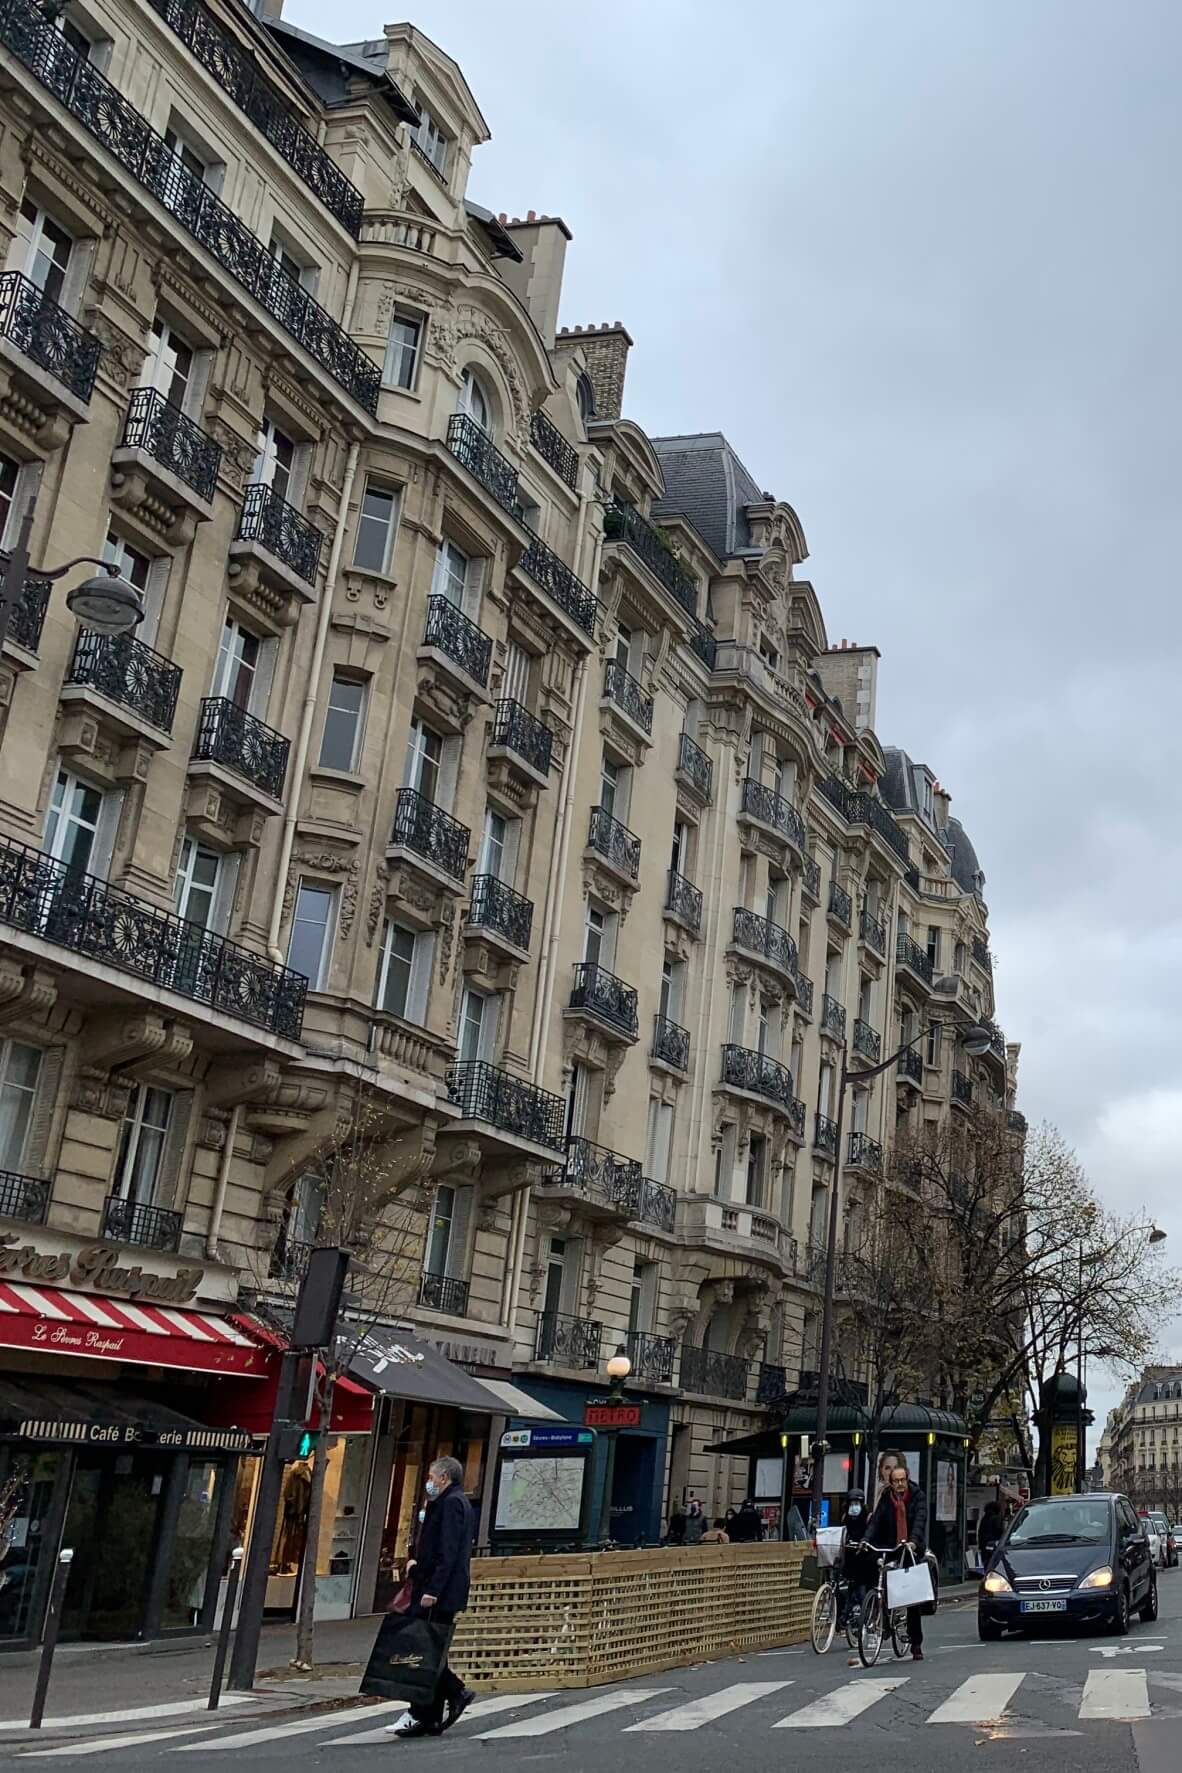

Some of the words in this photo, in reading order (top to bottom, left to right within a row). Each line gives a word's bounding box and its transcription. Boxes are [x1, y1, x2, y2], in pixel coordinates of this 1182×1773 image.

[31, 1324, 48, 1341] Le
[84, 1332, 124, 1352] Raspail
[90, 1425, 120, 1441] Café
